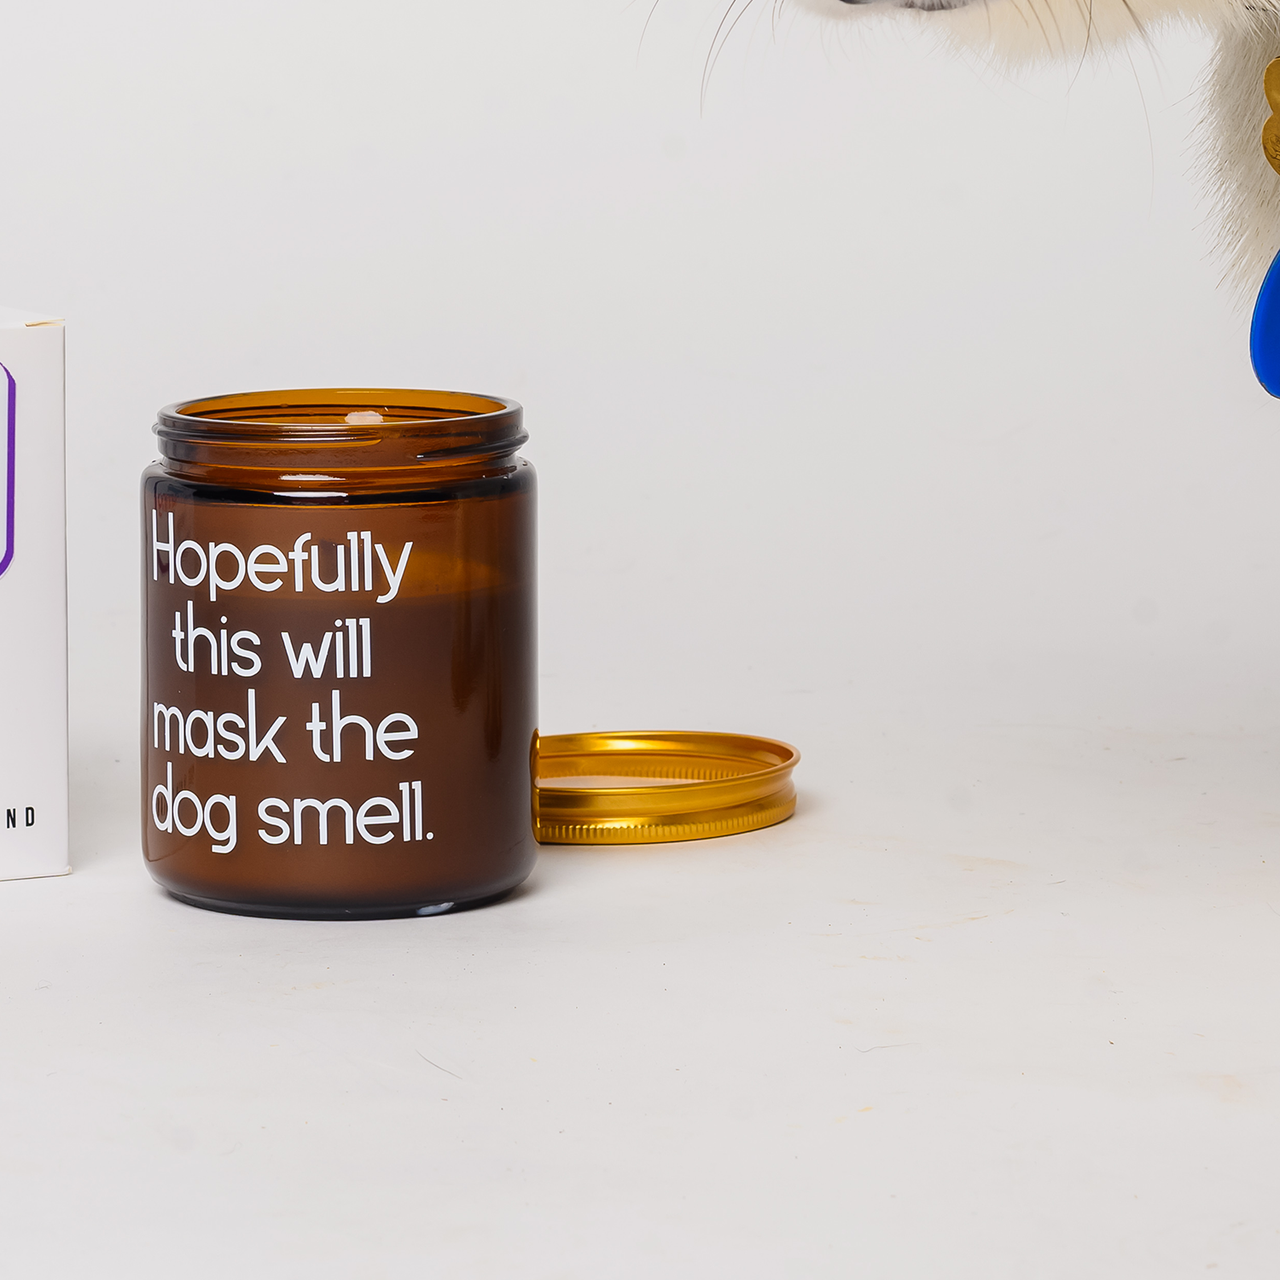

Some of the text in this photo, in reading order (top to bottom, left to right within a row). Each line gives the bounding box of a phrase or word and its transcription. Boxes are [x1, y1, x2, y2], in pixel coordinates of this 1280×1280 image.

[152, 508, 413, 603] Hopefully
[172, 600, 371, 679] this will
[153, 688, 419, 763] mask the
[152, 762, 434, 853] dog smell.
